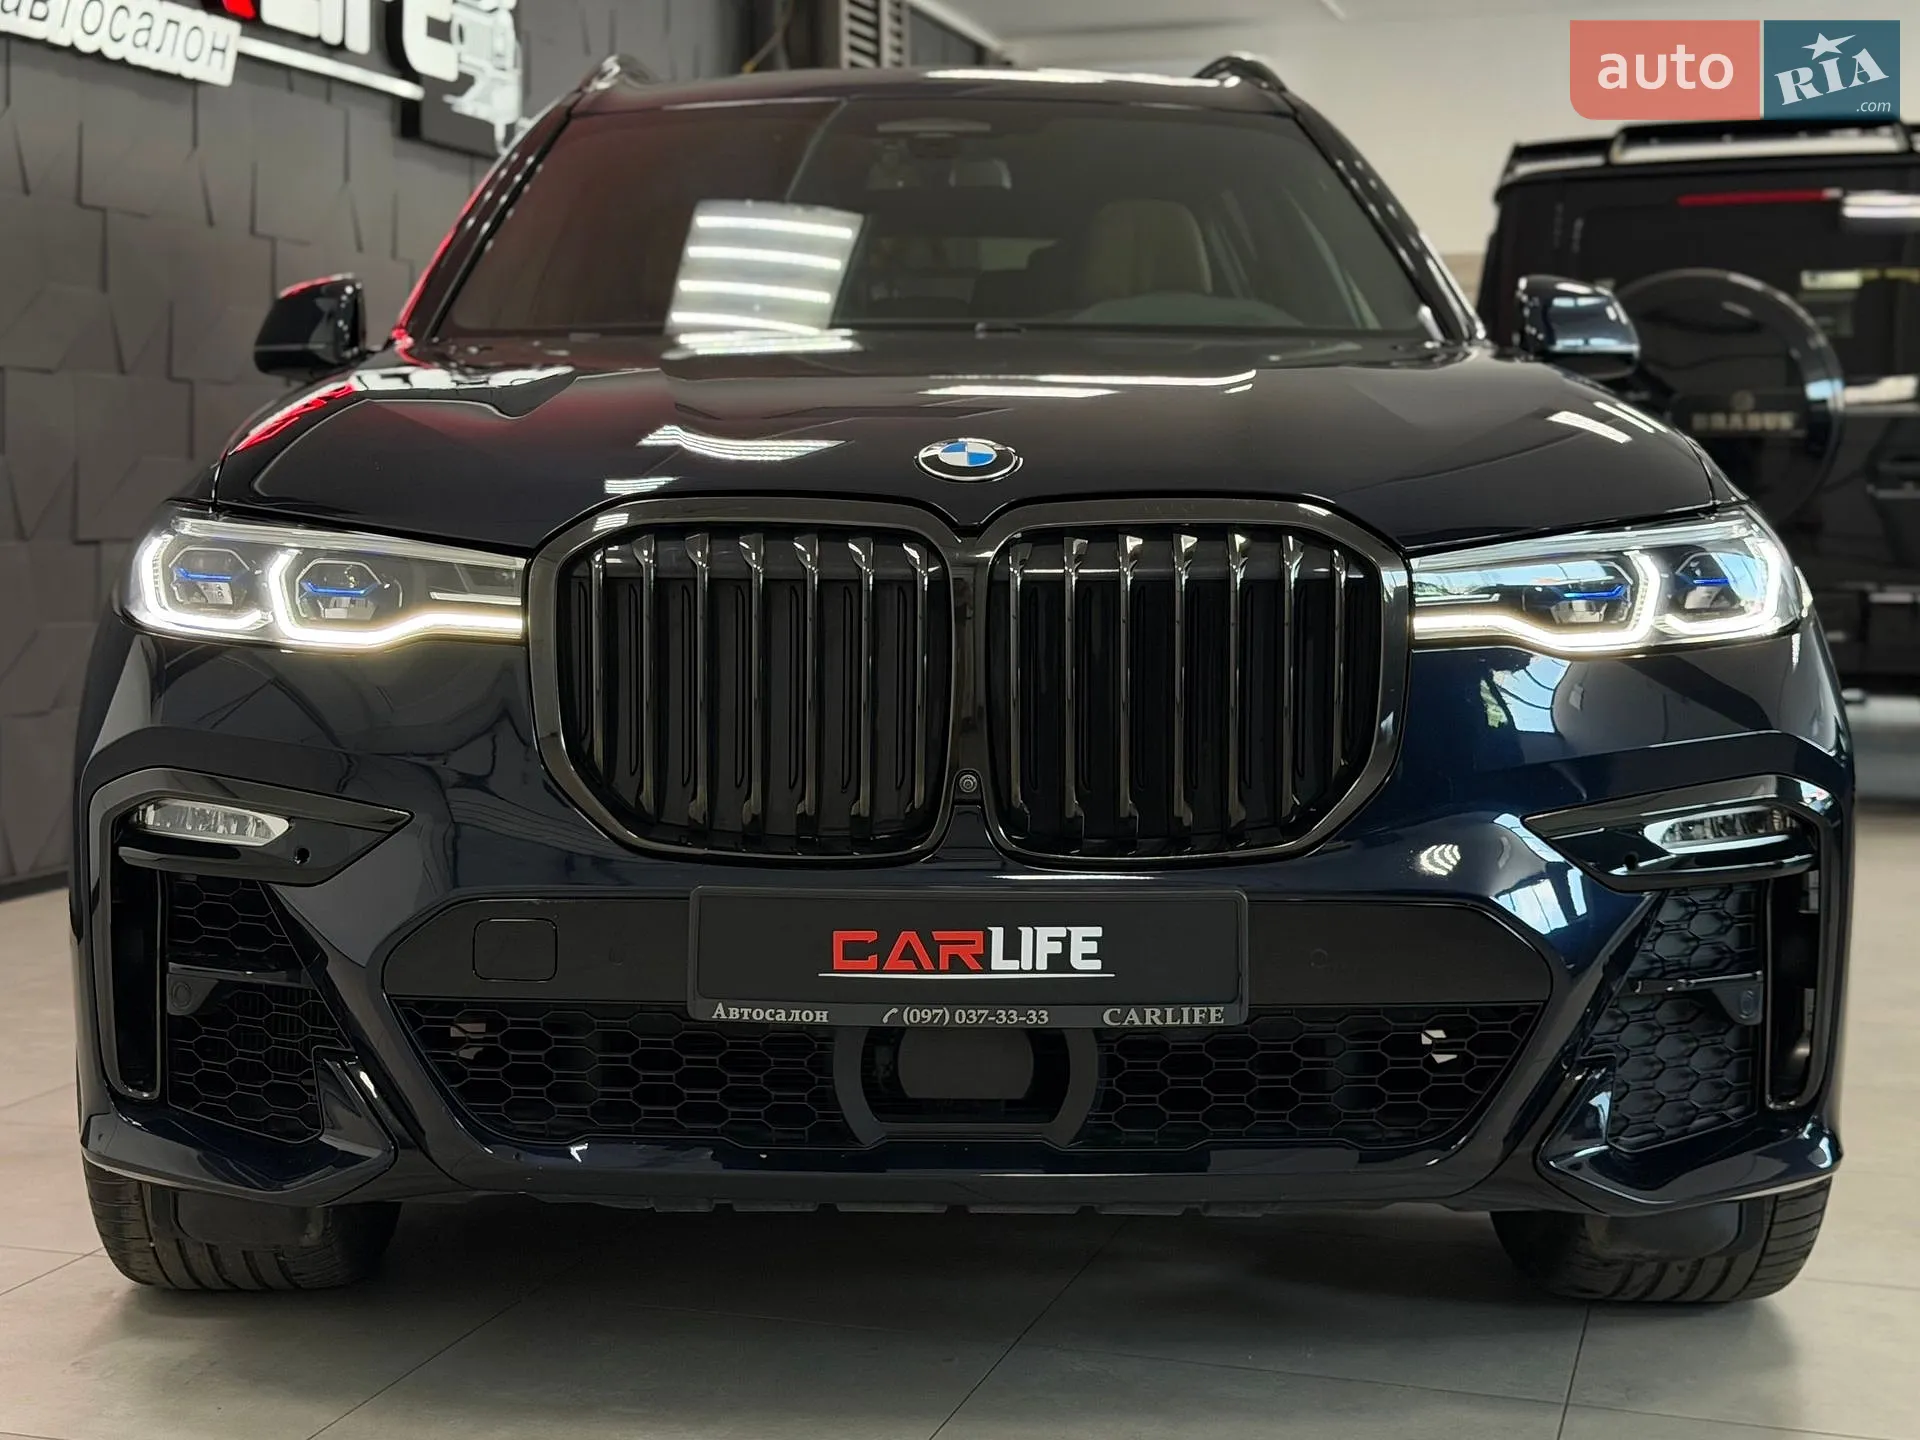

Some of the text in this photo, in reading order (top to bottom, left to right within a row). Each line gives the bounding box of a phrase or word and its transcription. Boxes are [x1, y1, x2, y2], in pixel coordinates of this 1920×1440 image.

[833, 926, 1103, 971] CARLIFE
[712, 1003, 1225, 1026] Автосалон (097) 037-33-33 CARLIFE
